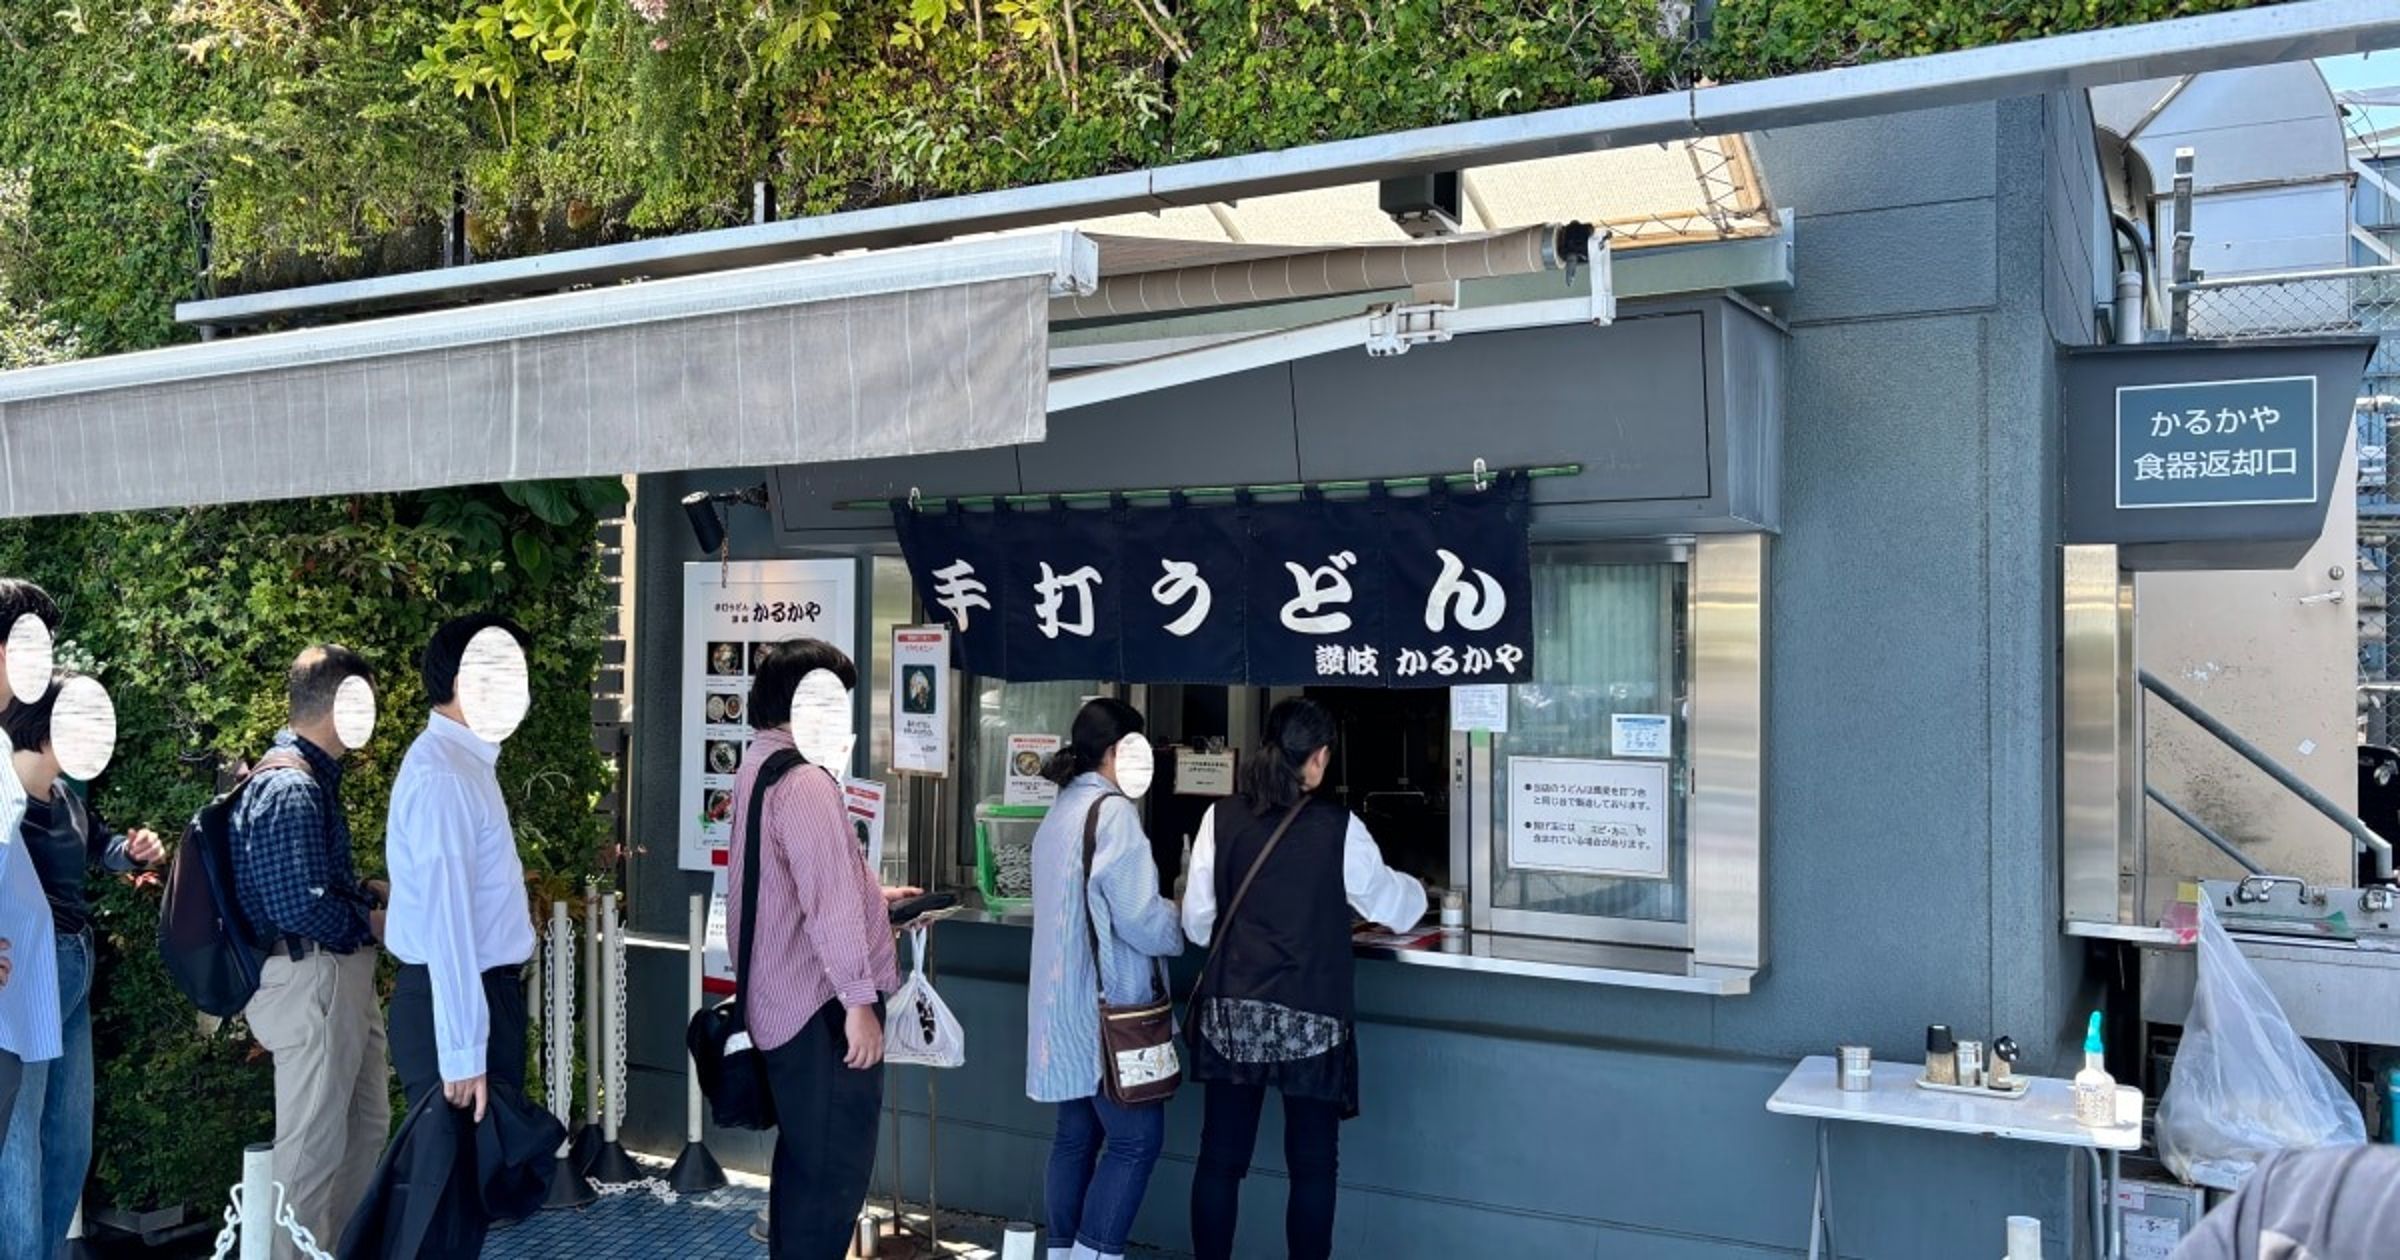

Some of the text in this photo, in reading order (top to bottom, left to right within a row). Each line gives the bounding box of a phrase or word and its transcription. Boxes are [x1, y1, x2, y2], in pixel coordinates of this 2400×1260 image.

[2150, 405, 2280, 437] かるかや
[2133, 447, 2297, 482] 食器返却口
[931, 549, 1507, 639] 手打うどん
[753, 601, 821, 623] かるかや
[1396, 643, 1523, 675] かるかや
